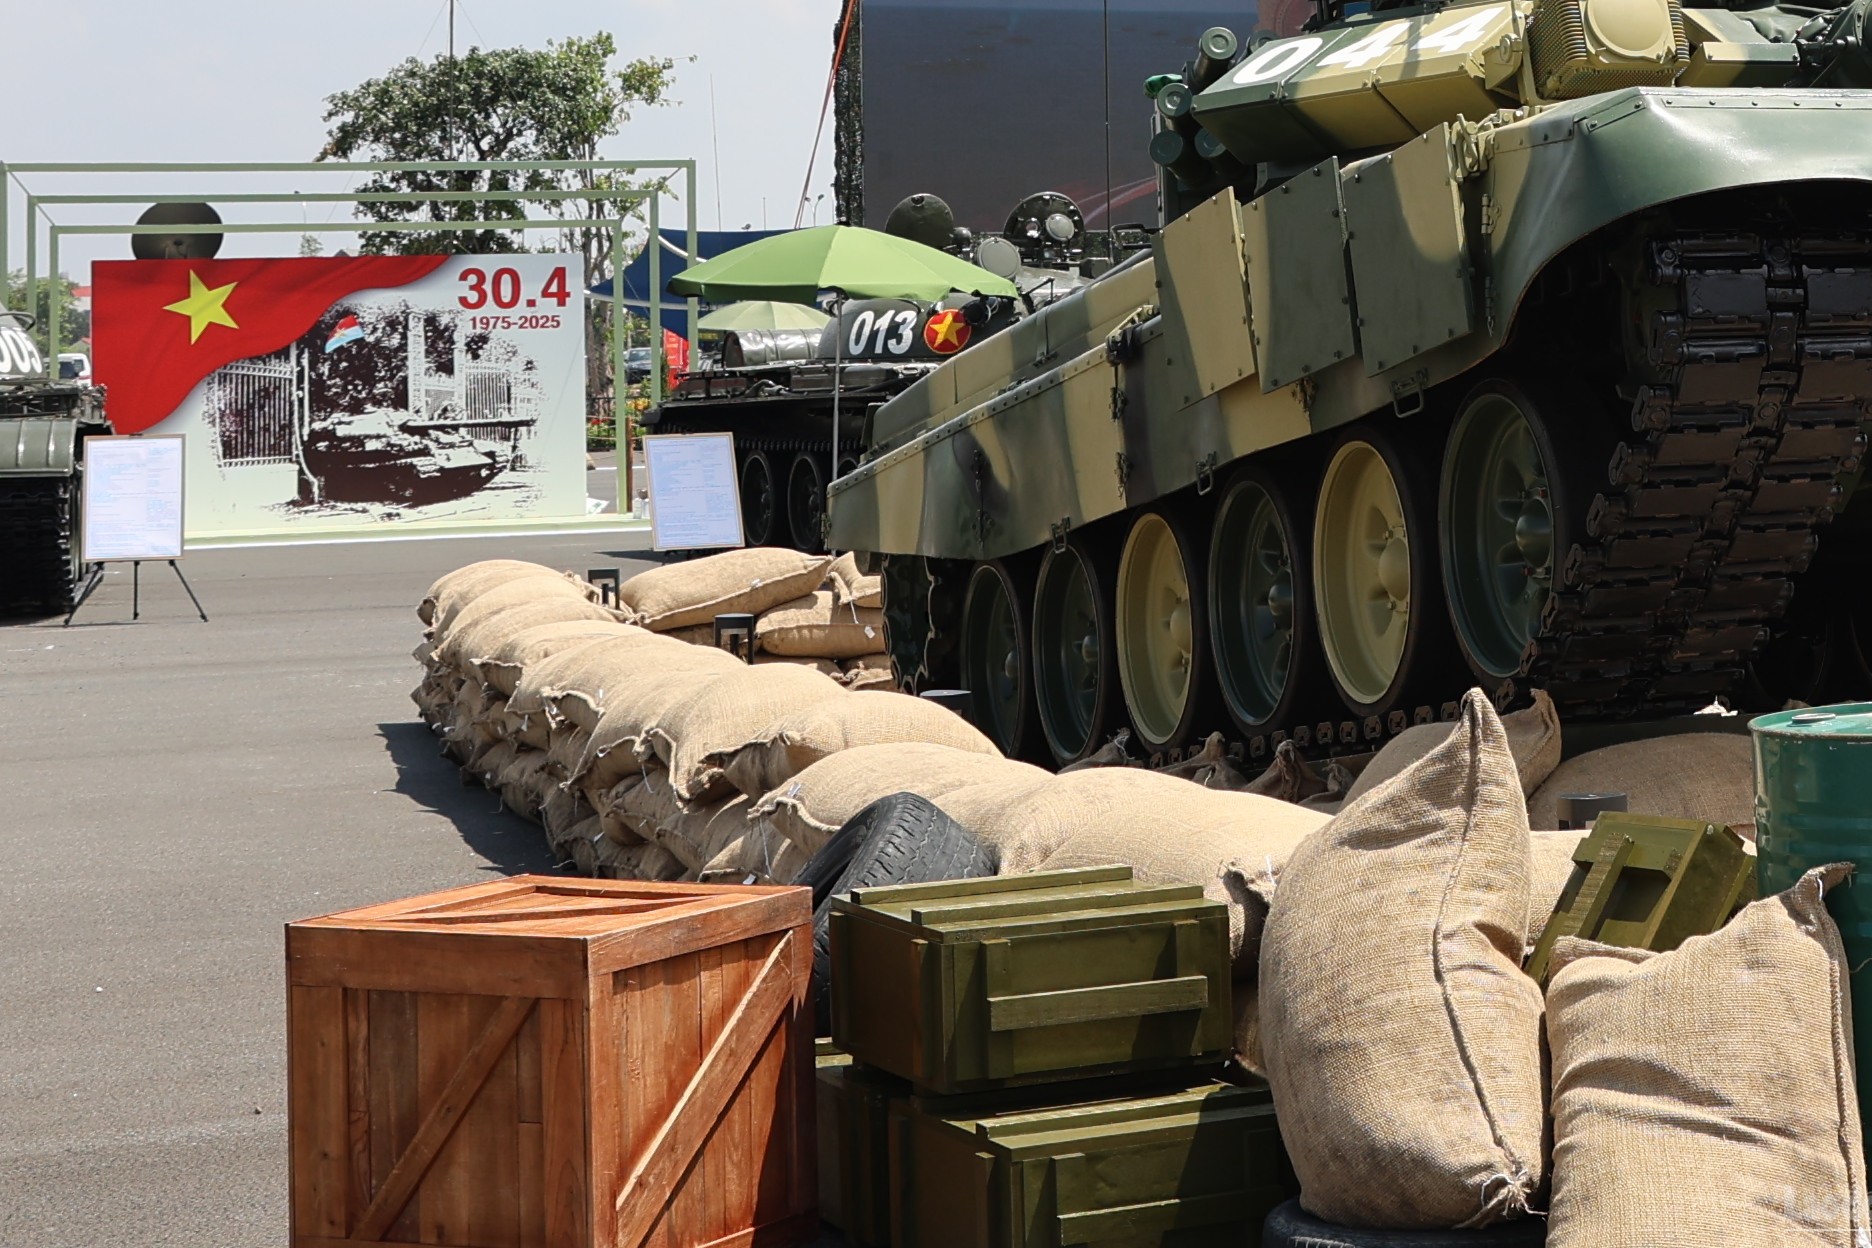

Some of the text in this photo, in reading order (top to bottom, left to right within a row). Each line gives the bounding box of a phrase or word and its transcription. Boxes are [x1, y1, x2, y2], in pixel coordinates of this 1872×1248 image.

[1232, 6, 1507, 85] 044
[458, 266, 572, 310] 30.4
[470, 315, 561, 331] 1975-2025
[848, 309, 918, 356] 013
